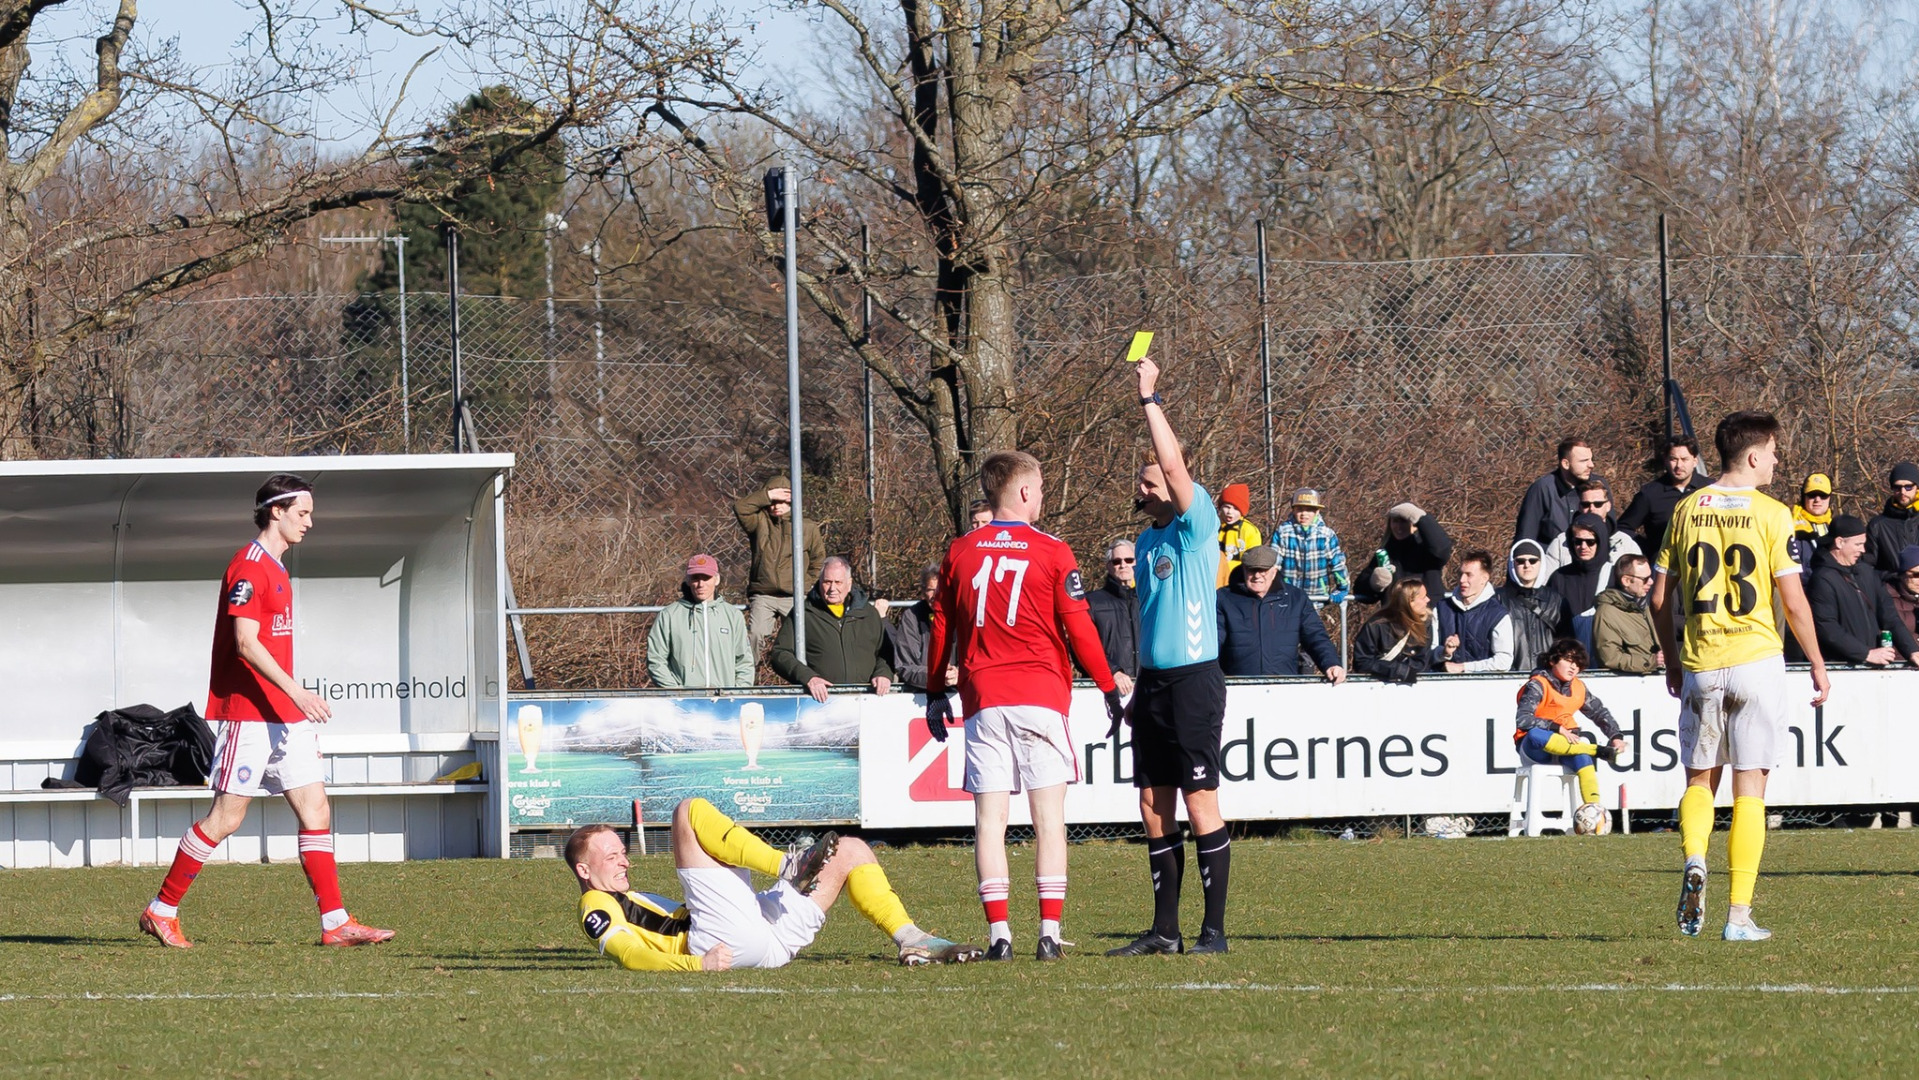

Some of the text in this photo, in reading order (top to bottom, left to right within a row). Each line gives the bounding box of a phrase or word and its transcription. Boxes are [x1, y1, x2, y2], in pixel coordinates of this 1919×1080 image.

[1691, 514, 1753, 529] MEHANOVIC
[972, 555, 1029, 627] 17
[1688, 542, 1757, 617] 23
